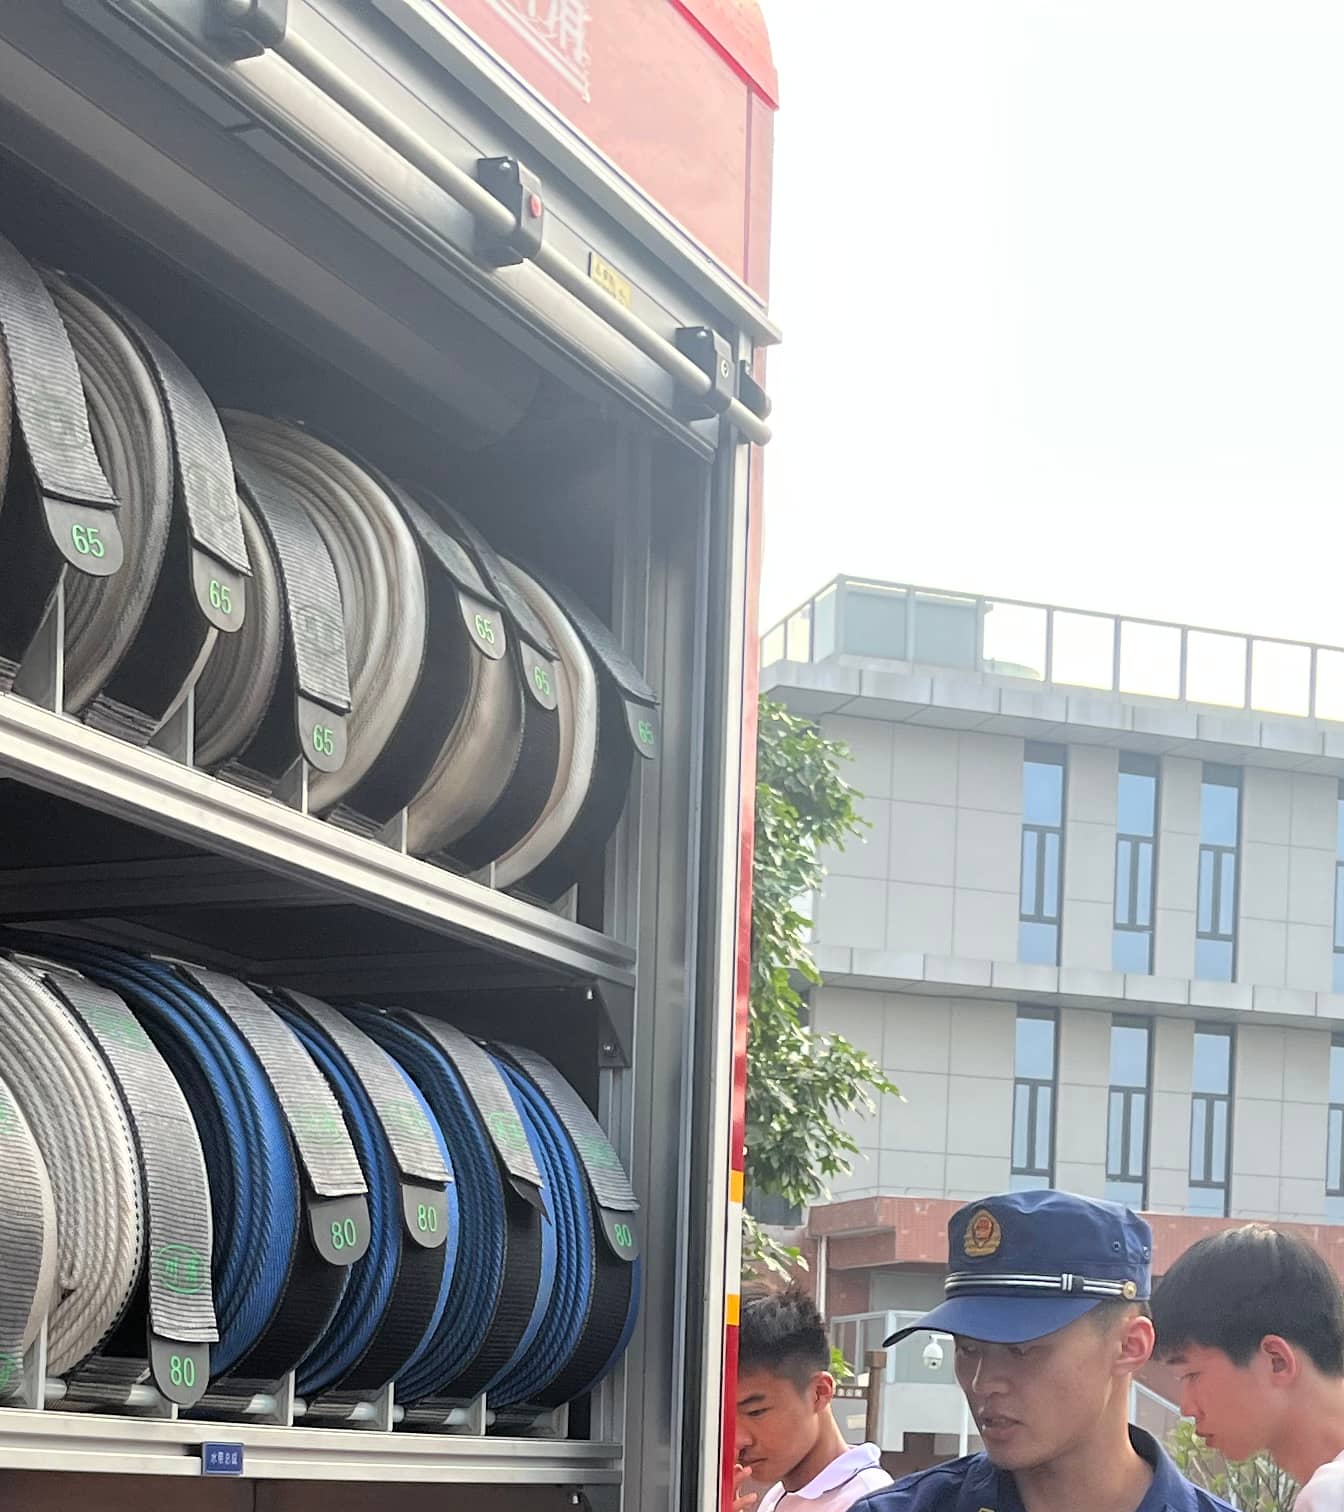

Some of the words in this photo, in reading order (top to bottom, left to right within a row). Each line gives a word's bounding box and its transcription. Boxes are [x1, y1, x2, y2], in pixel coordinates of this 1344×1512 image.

[71, 523, 106, 559] 65
[208, 580, 233, 613] 65
[474, 613, 496, 645] 65
[533, 667, 553, 698] 65
[312, 725, 336, 756] 65
[638, 718, 654, 745] 65
[416, 1203, 439, 1233] 80
[330, 1218, 358, 1250] 80
[614, 1223, 634, 1247] 80
[169, 1355, 197, 1388] 80
